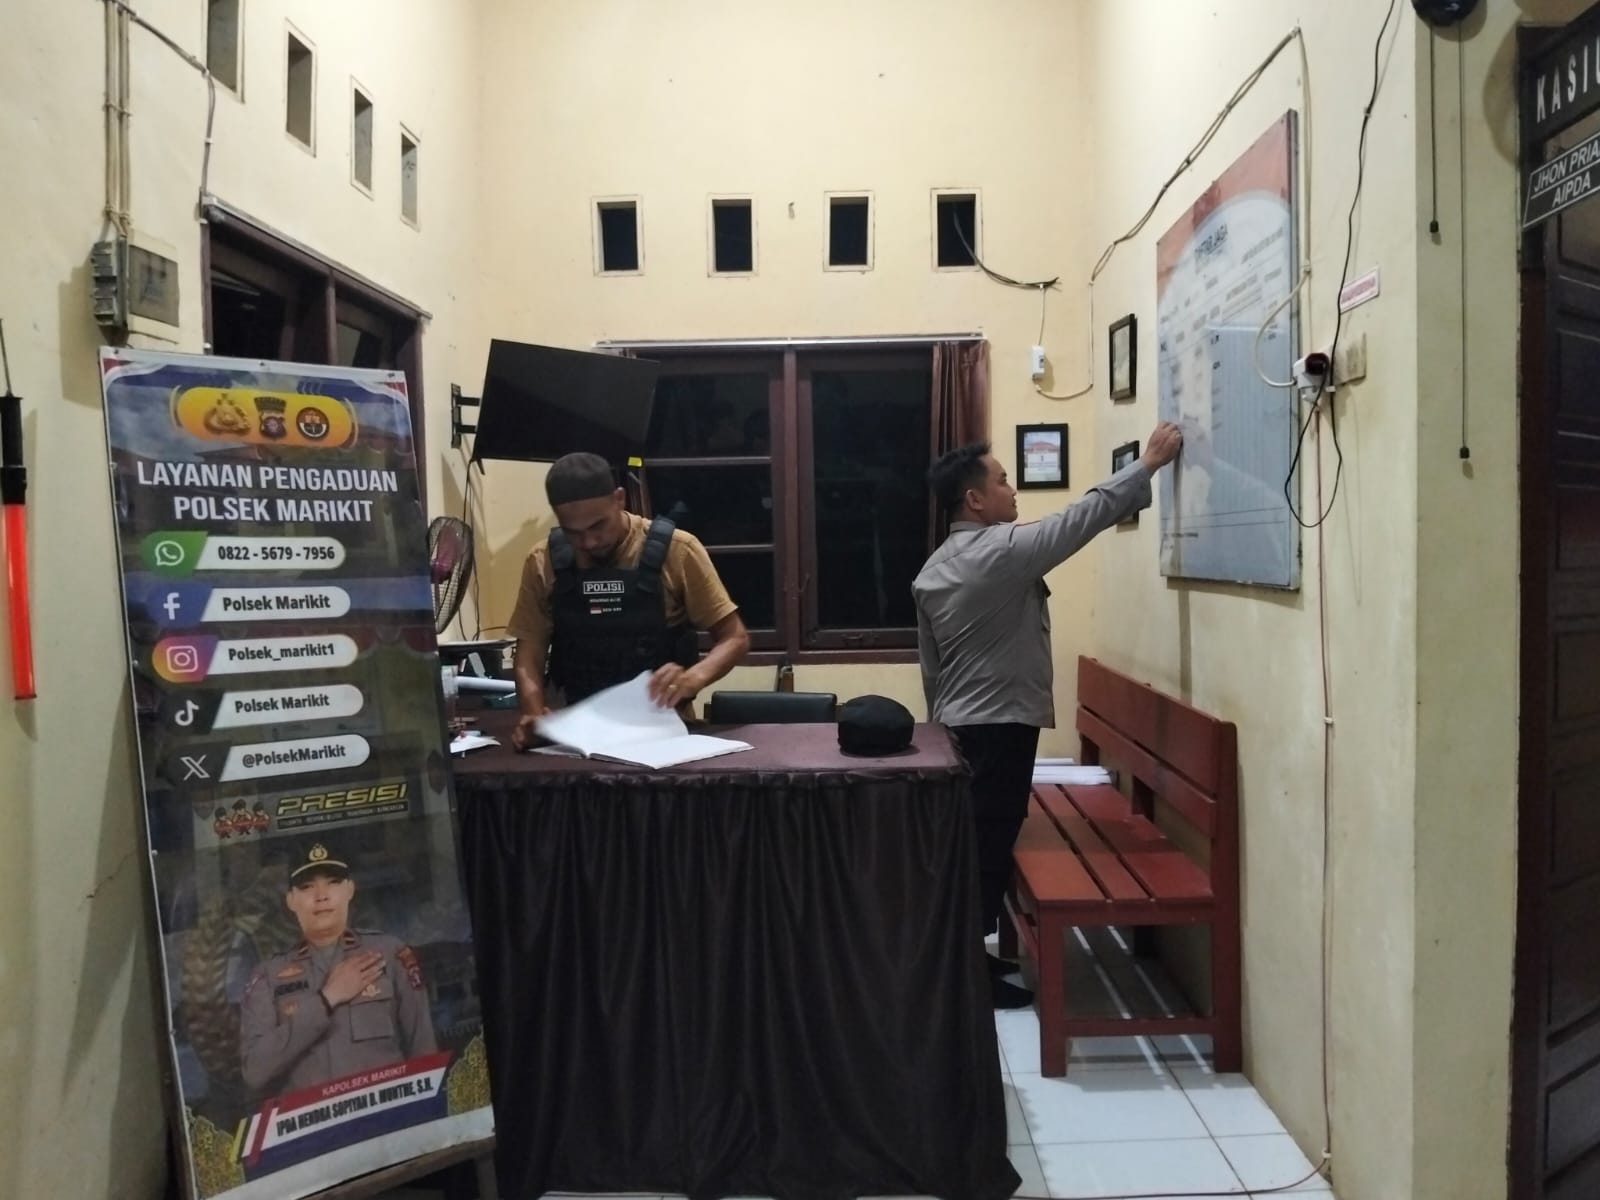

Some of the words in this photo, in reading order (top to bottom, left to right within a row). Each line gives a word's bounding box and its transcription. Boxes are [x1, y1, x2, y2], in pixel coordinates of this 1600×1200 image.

[1534, 156, 1567, 192] JHON
[1552, 171, 1590, 208] AIPDA
[137, 461, 252, 488] LAYANAN
[260, 466, 398, 492] PENGADUAN
[174, 496, 271, 521] POLSEK
[276, 500, 372, 522] MARIKIT
[218, 546, 250, 560] 0822
[261, 546, 293, 560] 5679
[303, 546, 335, 560] 7956
[586, 583, 621, 592] POLISI
[223, 596, 272, 611] Polsek
[276, 594, 331, 610] Marikit
[228, 643, 335, 662] Polsek_marikit1
[234, 698, 278, 713] Polsek
[282, 693, 330, 709] Marikit
[242, 744, 347, 768] @PolsekMarikit
[277, 783, 408, 816] PRESISI
[322, 1073, 369, 1096] KAPOLSEK
[370, 1064, 408, 1082] MARIKIT
[276, 1116, 298, 1137] IPDA
[298, 1106, 332, 1129] HENDRA
